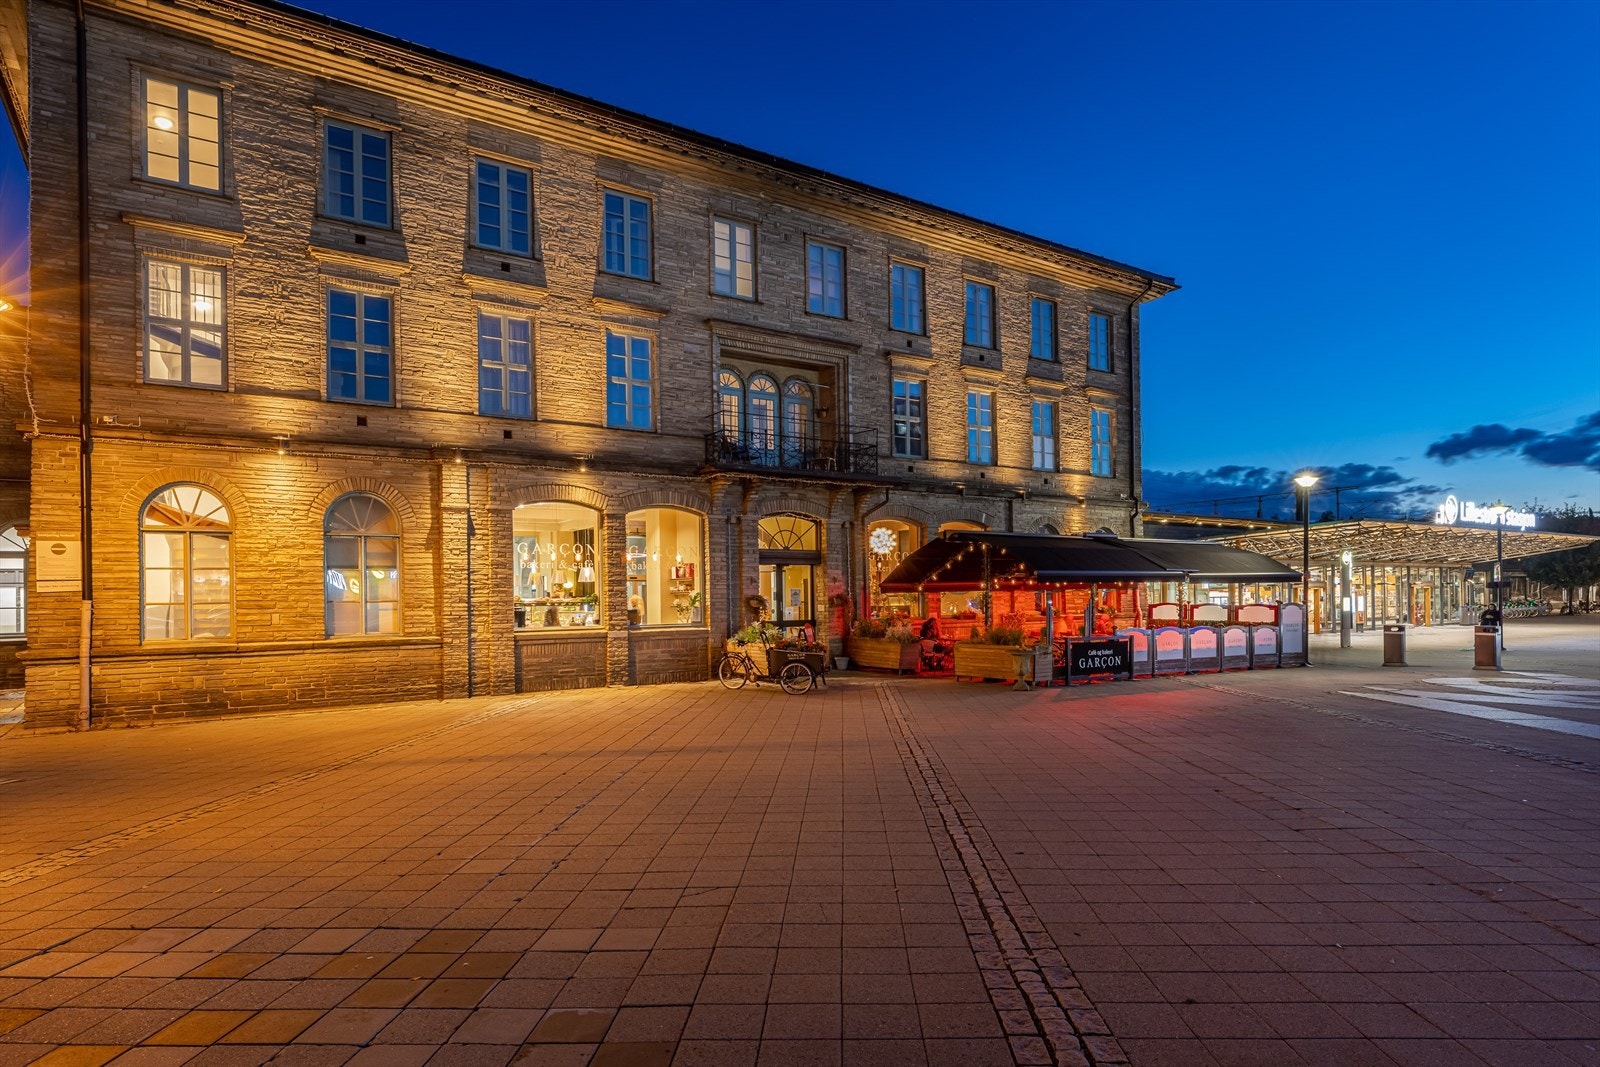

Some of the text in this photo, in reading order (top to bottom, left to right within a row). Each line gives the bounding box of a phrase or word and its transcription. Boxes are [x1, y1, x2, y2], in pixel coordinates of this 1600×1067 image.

[517, 542, 595, 557] GARÇON
[520, 560, 554, 569] bakeri
[559, 560, 568, 569] &
[1078, 656, 1121, 668] GARÇON
